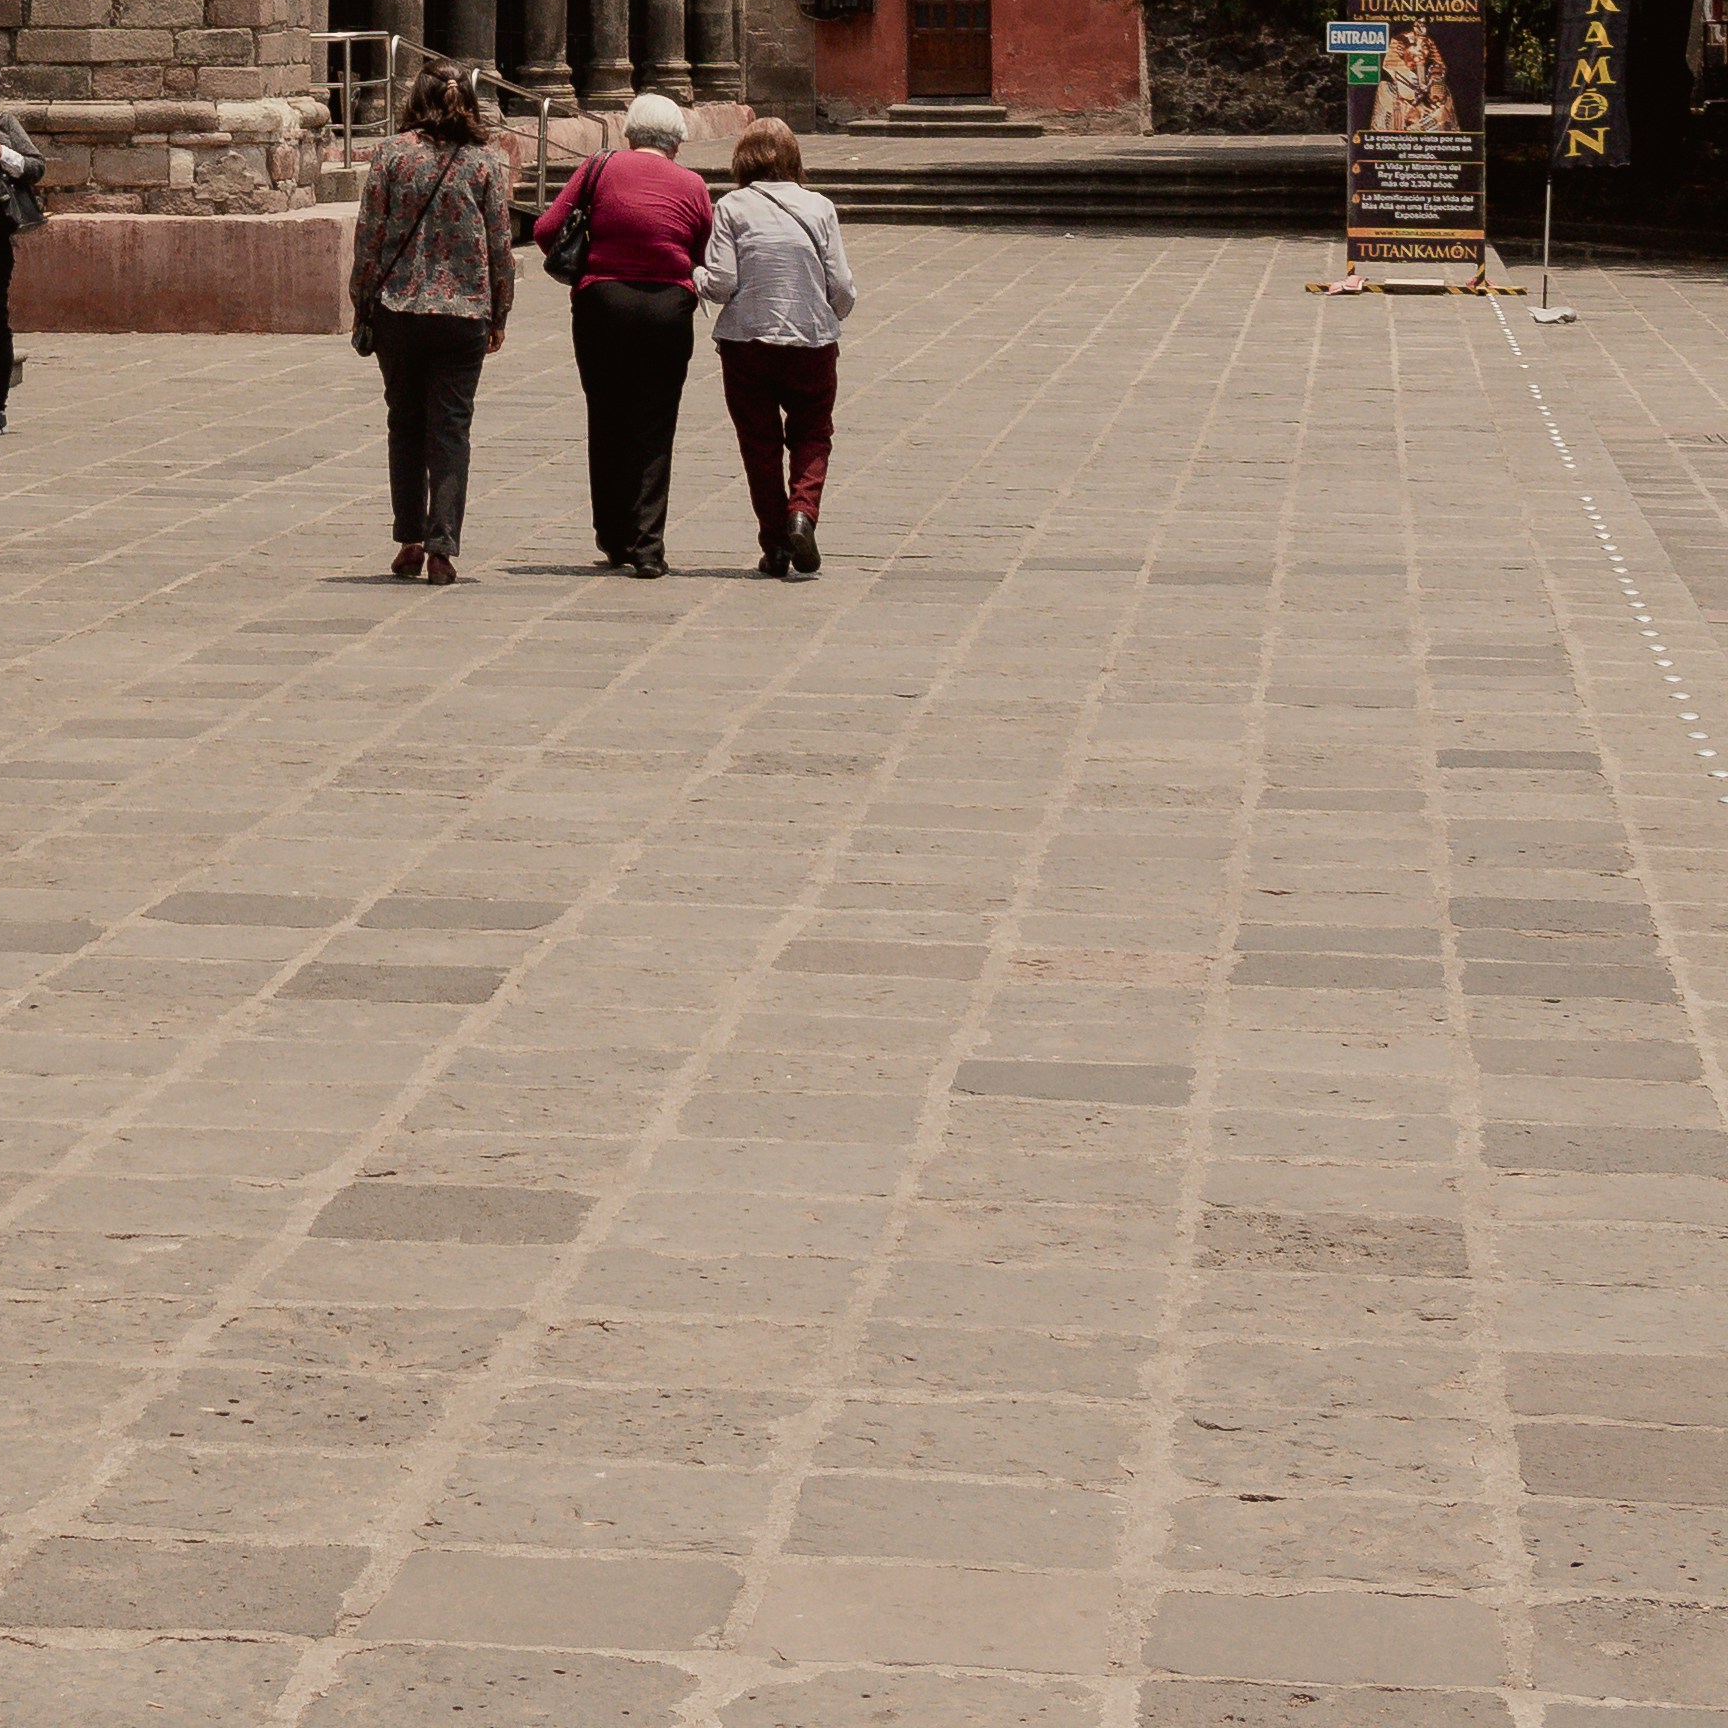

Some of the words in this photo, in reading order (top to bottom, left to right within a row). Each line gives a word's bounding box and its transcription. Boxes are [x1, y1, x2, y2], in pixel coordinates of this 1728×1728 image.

[1330, 30, 1385, 45] ENTRADA
[1364, 134, 1375, 142] La
[1439, 136, 1453, 144] por
[1424, 144, 1461, 152] personas
[1374, 162, 1385, 170] La
[1386, 162, 1404, 170] Vida
[1448, 163, 1462, 171] del
[1377, 171, 1393, 179] Rey
[1438, 172, 1459, 180] hace
[1361, 193, 1372, 201] La
[1460, 195, 1474, 203] del
[1357, 241, 1478, 260] TUTANKAMÓN
